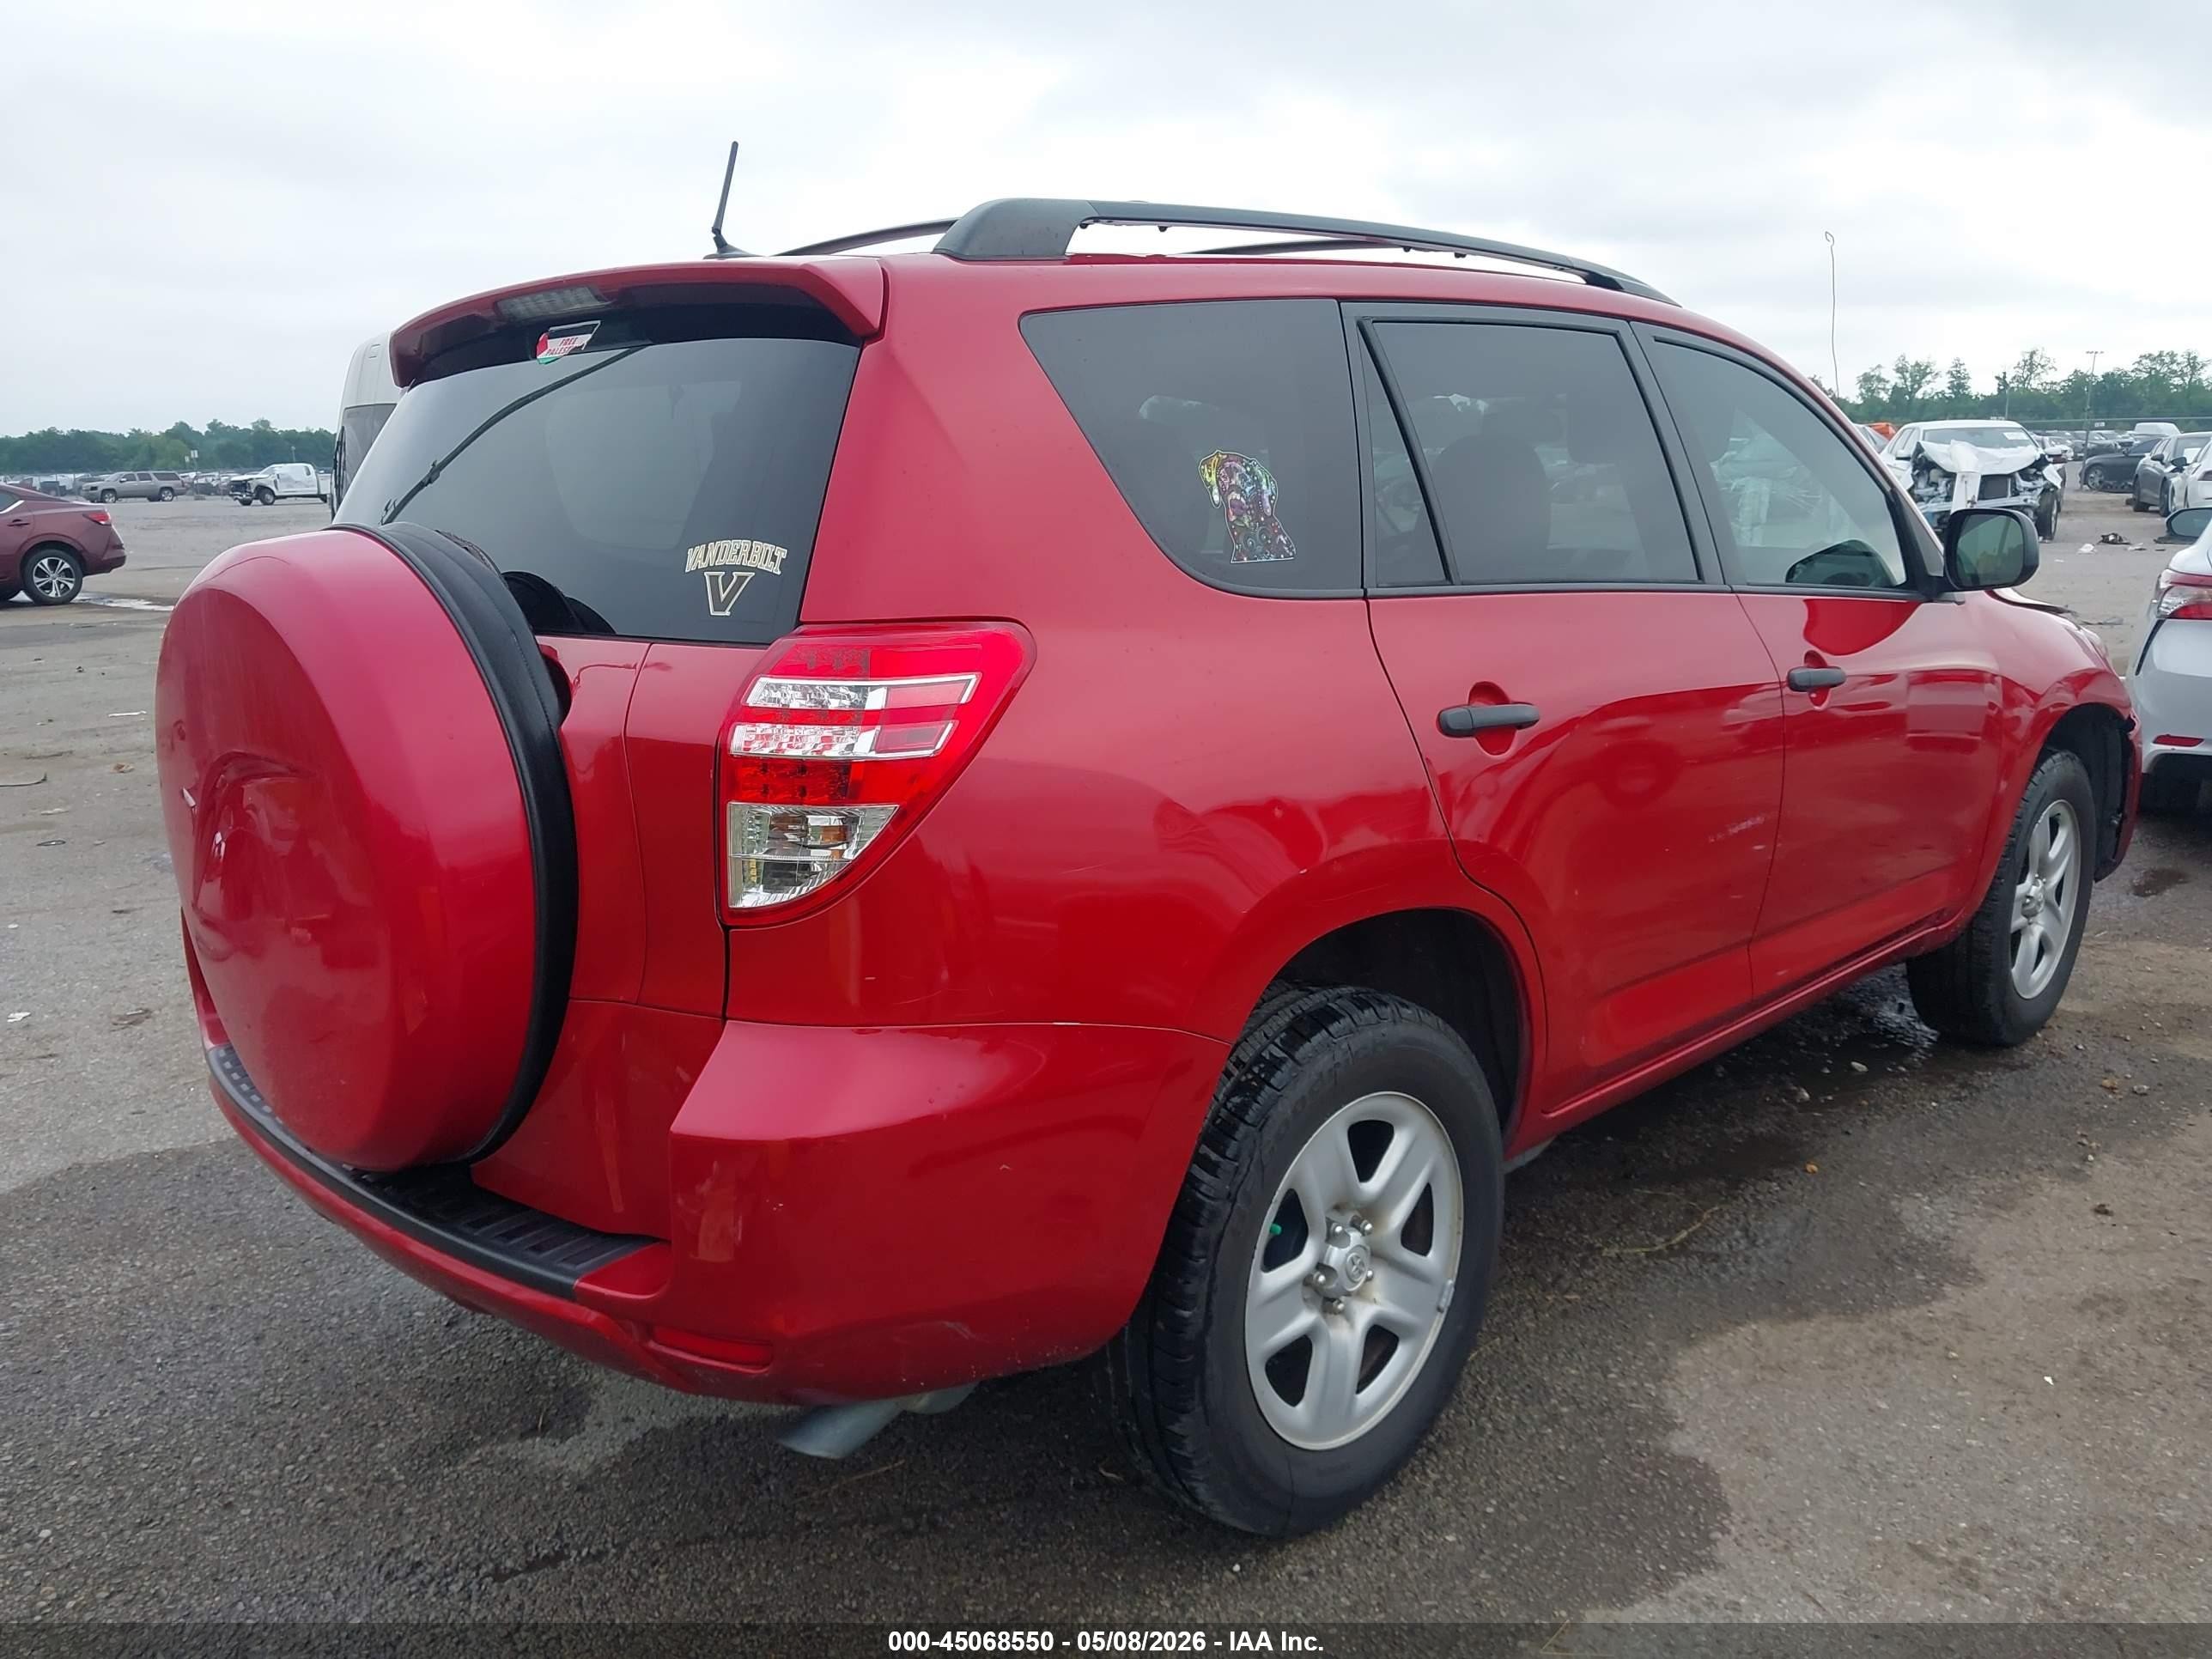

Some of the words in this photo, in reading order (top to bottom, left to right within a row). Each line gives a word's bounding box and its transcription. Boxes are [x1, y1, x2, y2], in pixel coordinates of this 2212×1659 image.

[559, 337, 578, 347] FREE
[685, 539, 787, 574] VANDERBILT
[704, 571, 755, 616] V
